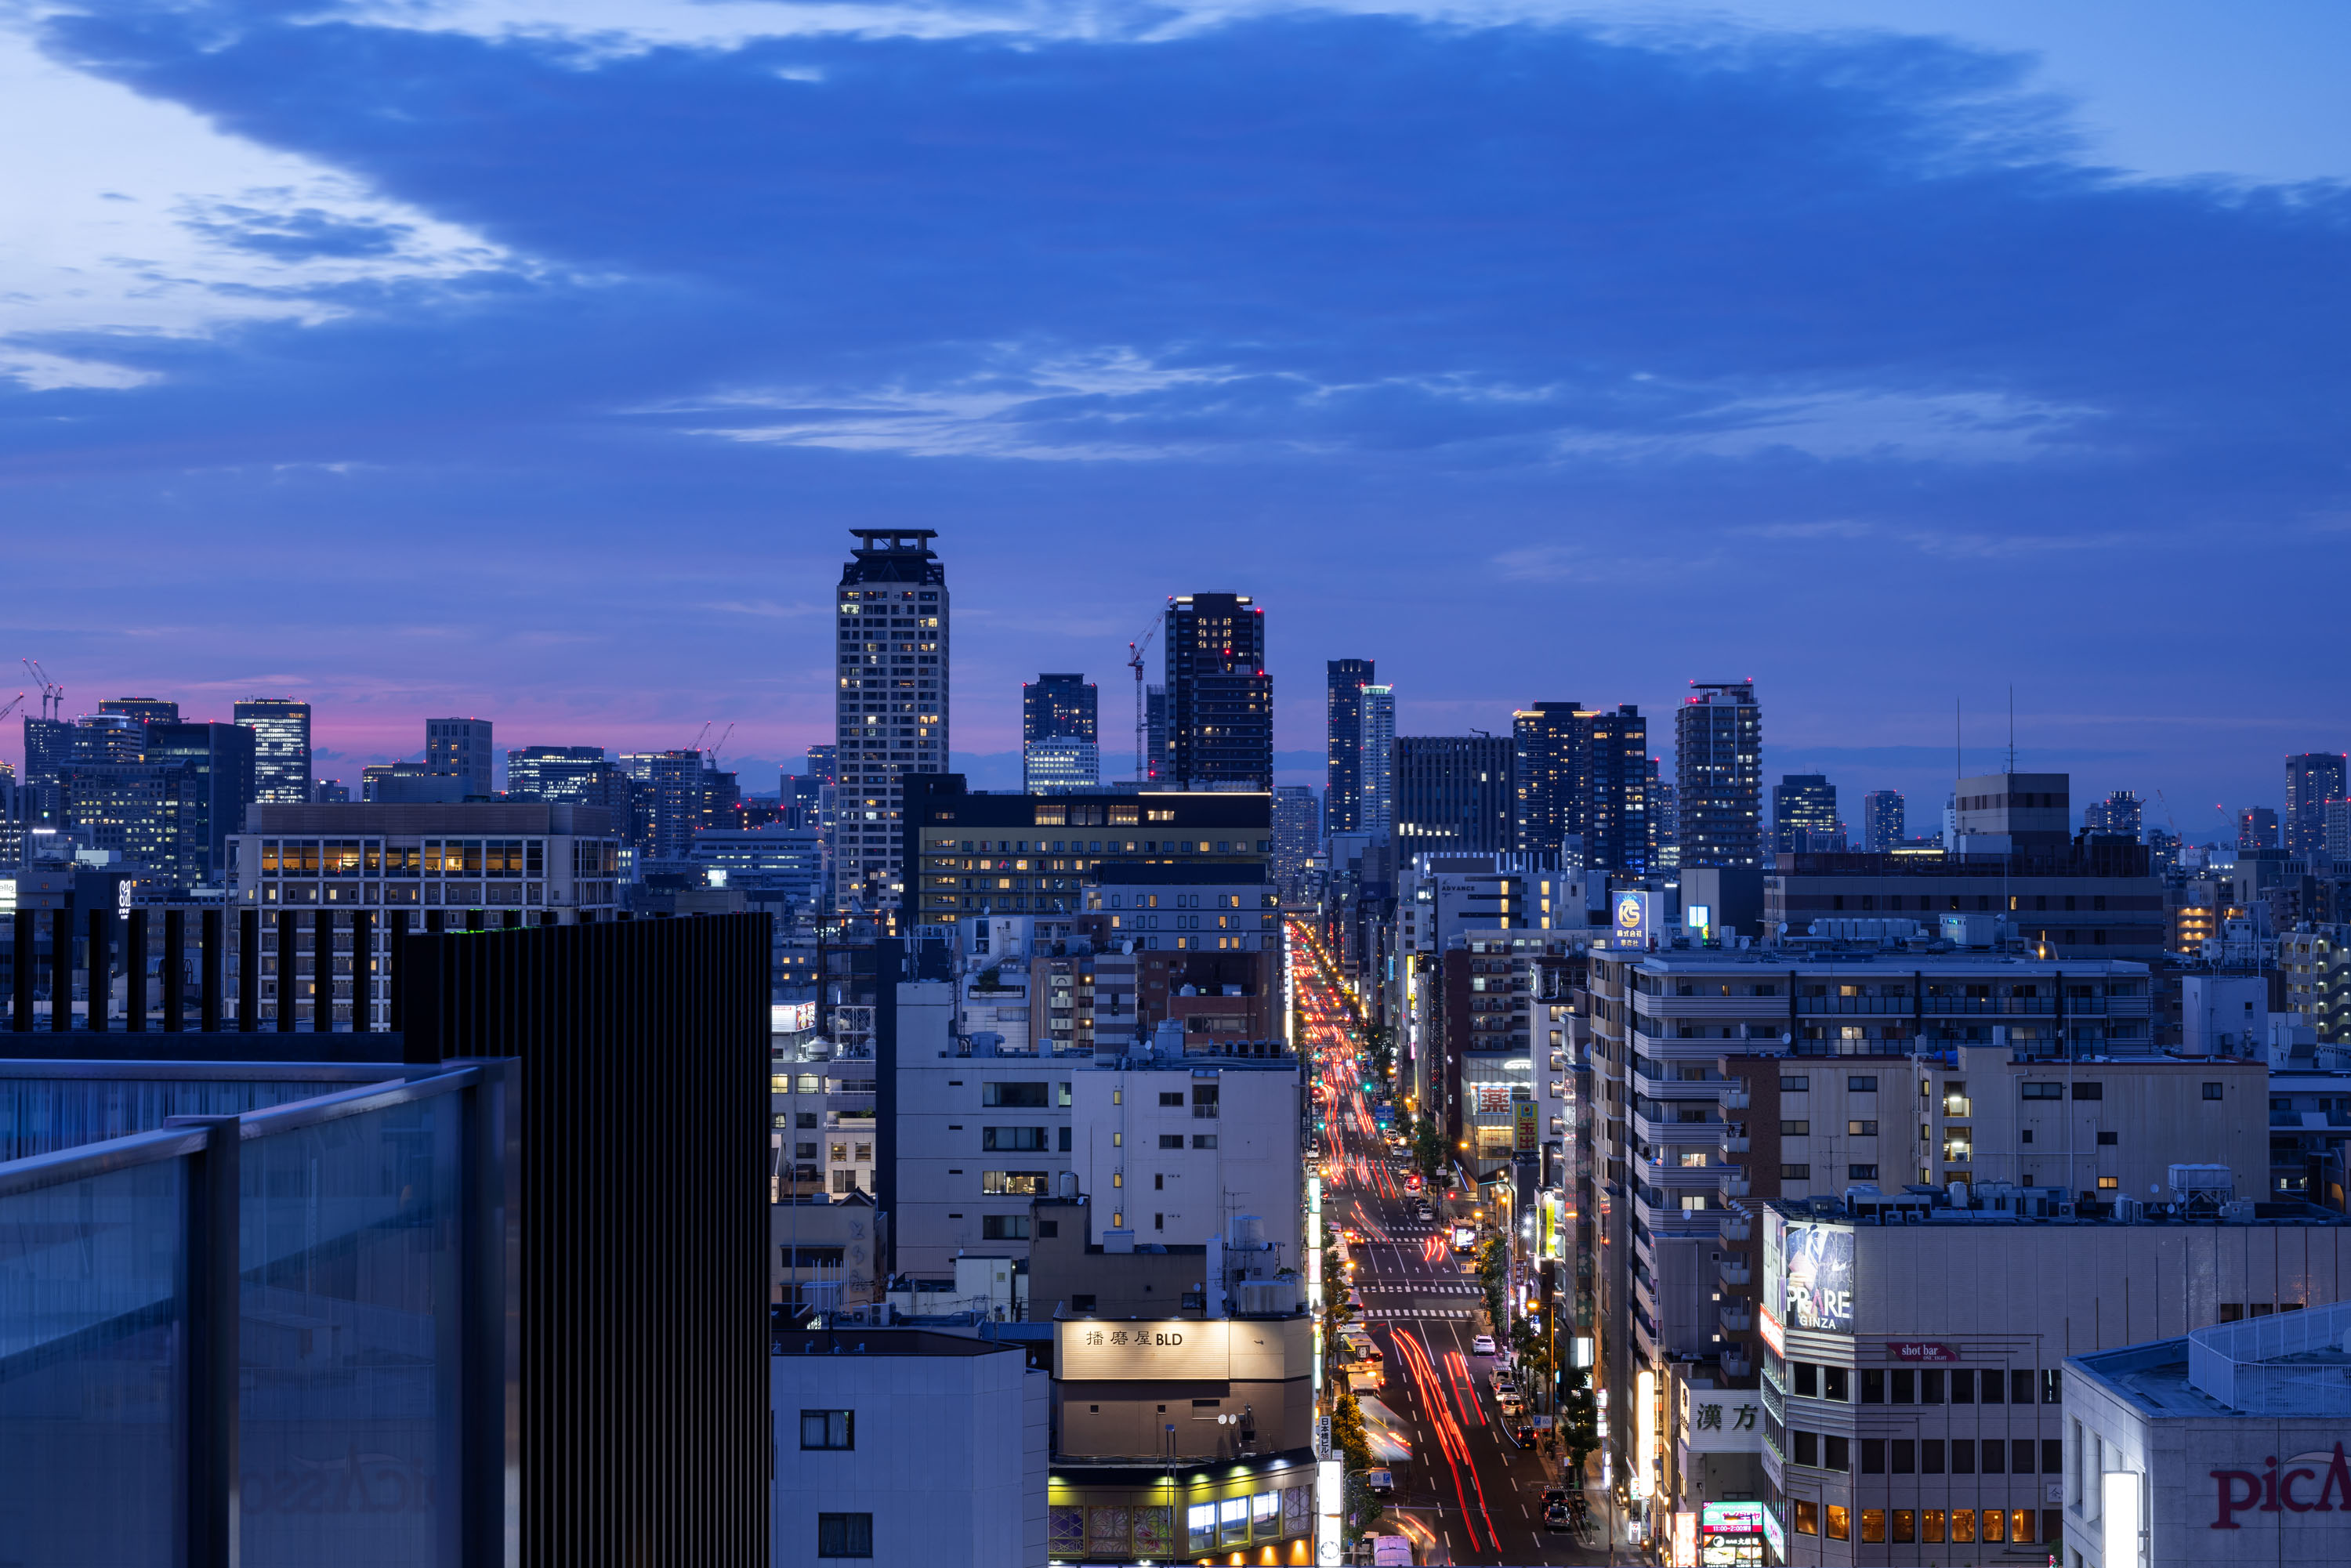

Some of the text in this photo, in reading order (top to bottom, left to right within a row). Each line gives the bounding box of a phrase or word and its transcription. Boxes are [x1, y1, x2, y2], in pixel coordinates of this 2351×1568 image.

[1480, 1088, 1510, 1113] 薬
[1519, 1122, 1535, 1149] 玉出
[1799, 1317, 1836, 1330] GINZA
[1086, 1331, 1183, 1345] 播磨屋 BLD
[1902, 1344, 1938, 1355] shot bar
[1697, 1403, 1759, 1431] 漢方
[1320, 1418, 1330, 1454] 日本橋ビル
